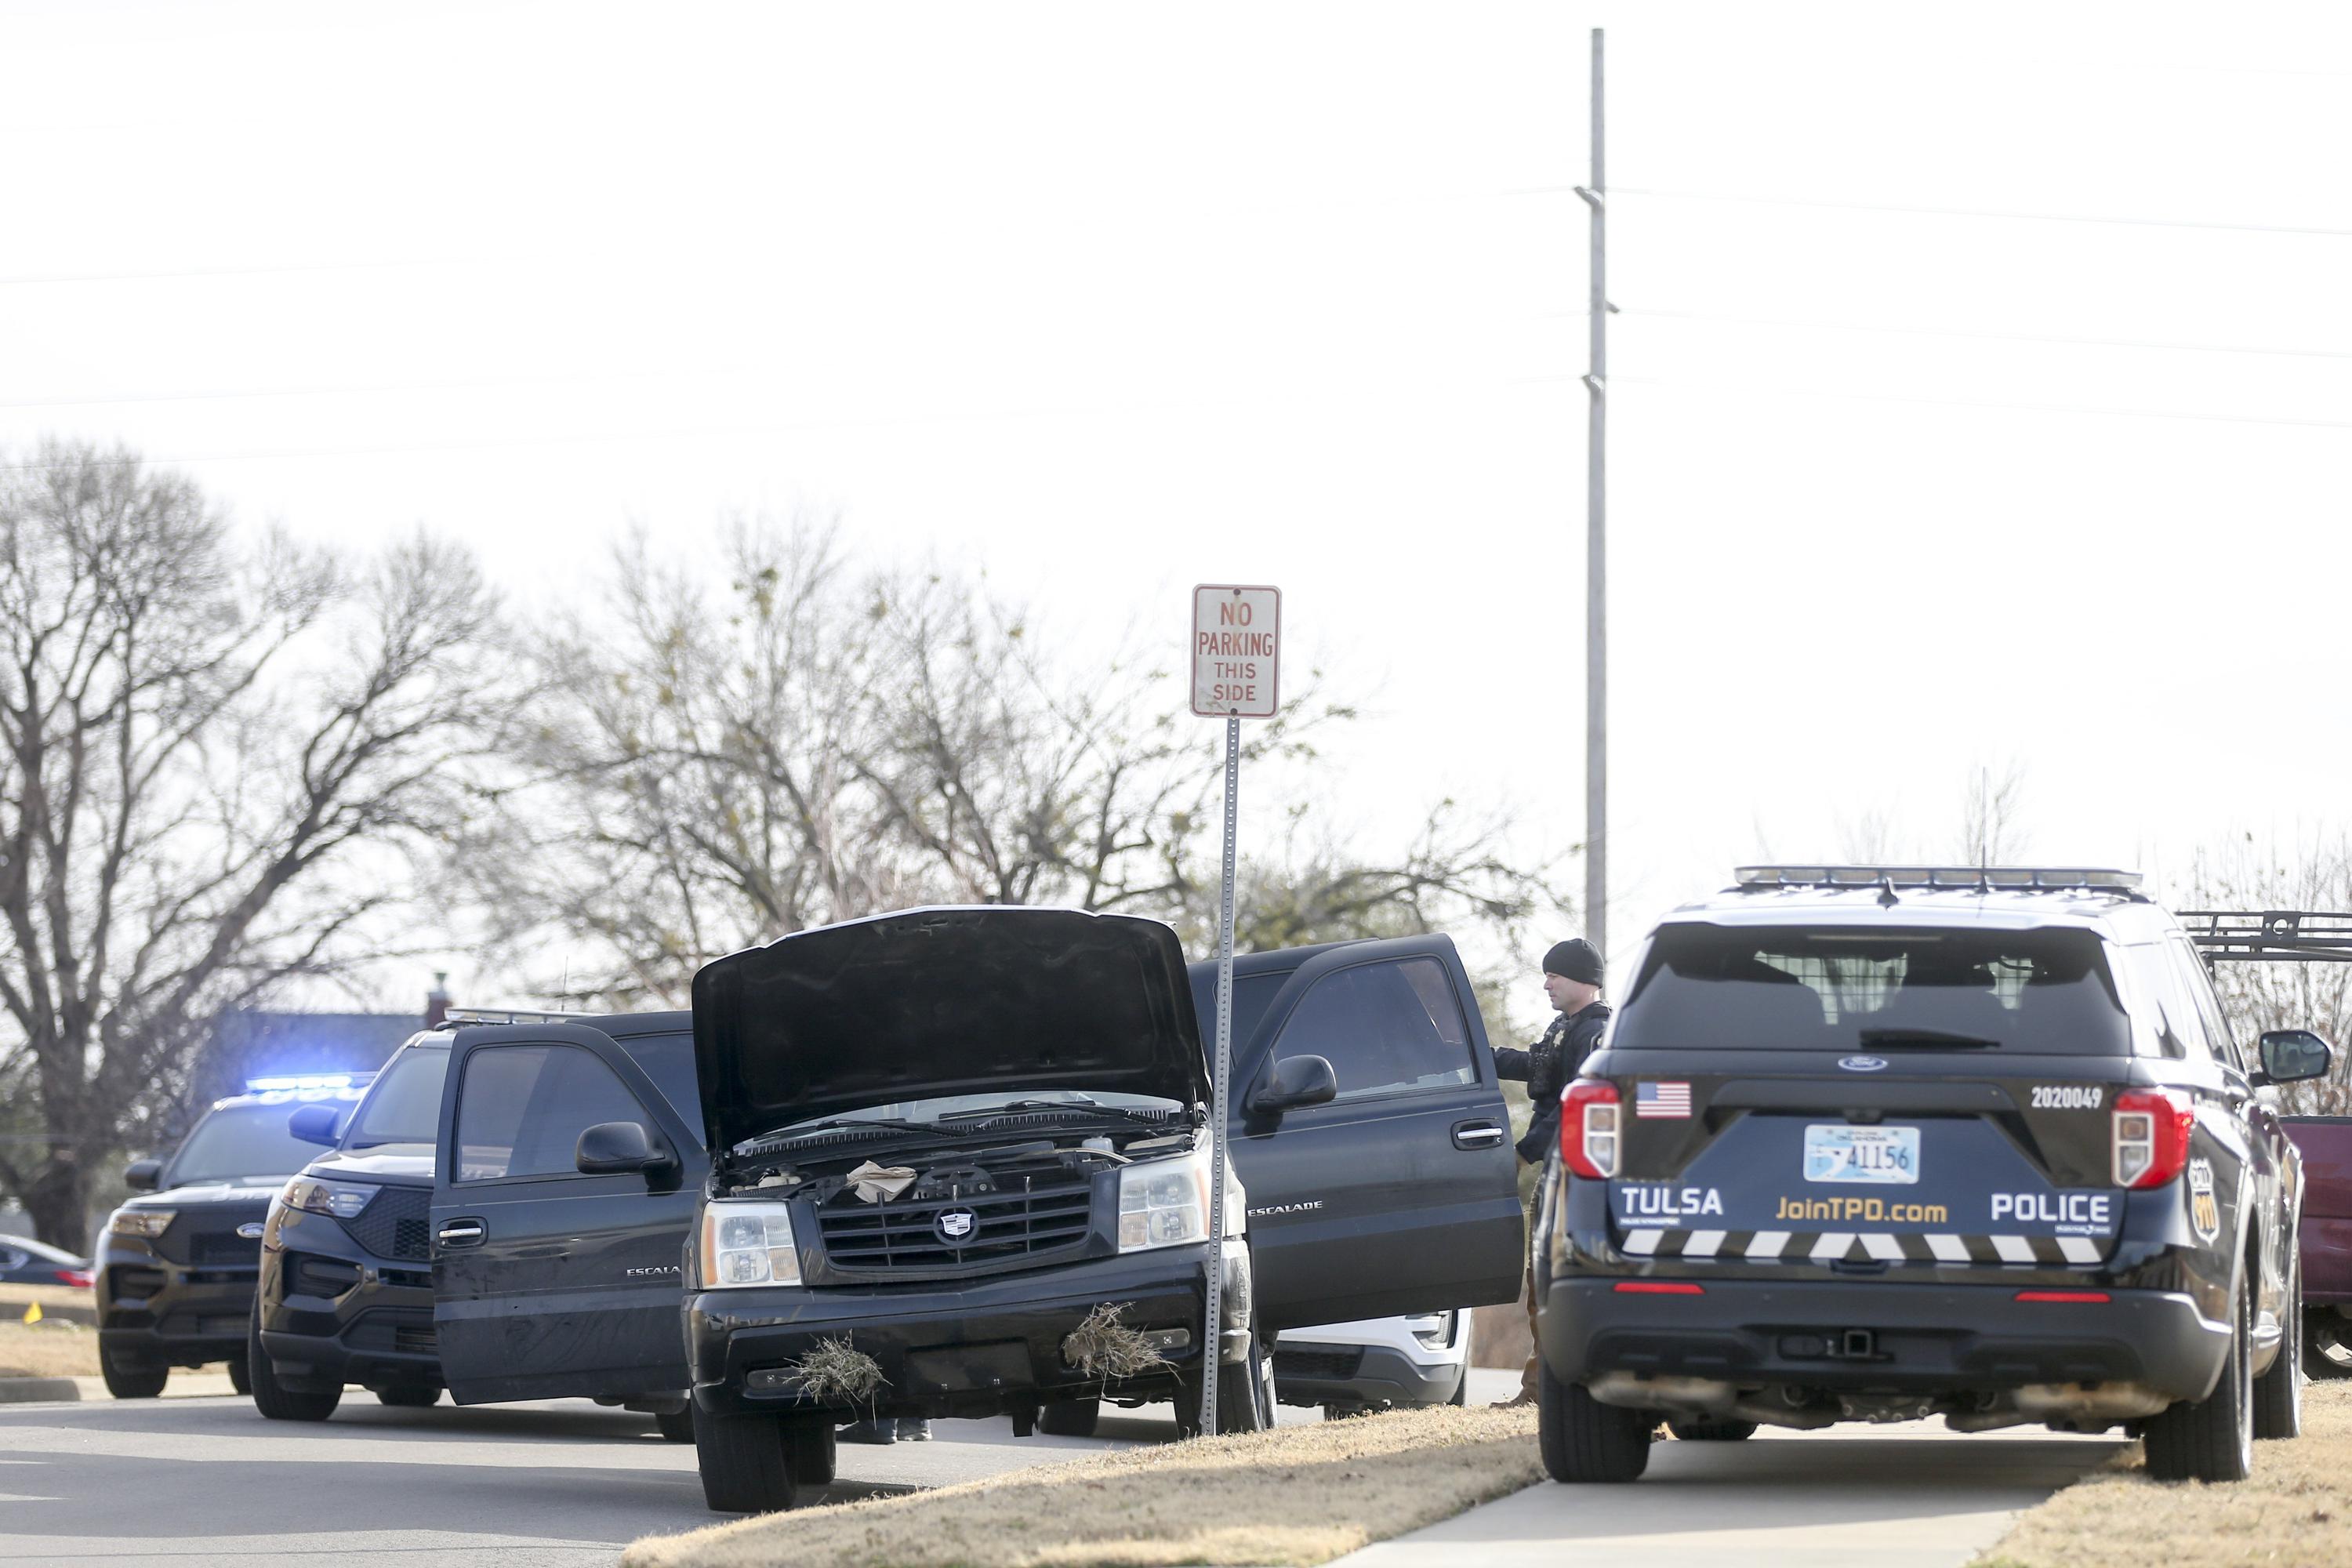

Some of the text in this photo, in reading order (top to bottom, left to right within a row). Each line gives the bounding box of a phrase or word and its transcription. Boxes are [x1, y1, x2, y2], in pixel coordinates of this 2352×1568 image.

[1220, 602, 1252, 626] NO
[1199, 632, 1273, 656] PARKING
[1214, 662, 1256, 679] THIS
[1213, 684, 1256, 701] SIDE
[2031, 1086, 2103, 1109] 2020049
[1847, 1145, 1908, 1170] 41156
[1247, 1200, 1323, 1217] ESCALADE
[1621, 1187, 1723, 1215] TULSA
[1776, 1196, 1947, 1223] JoinTPD.com
[1991, 1193, 2110, 1222] POLICE
[626, 1265, 682, 1276] ESCALA
